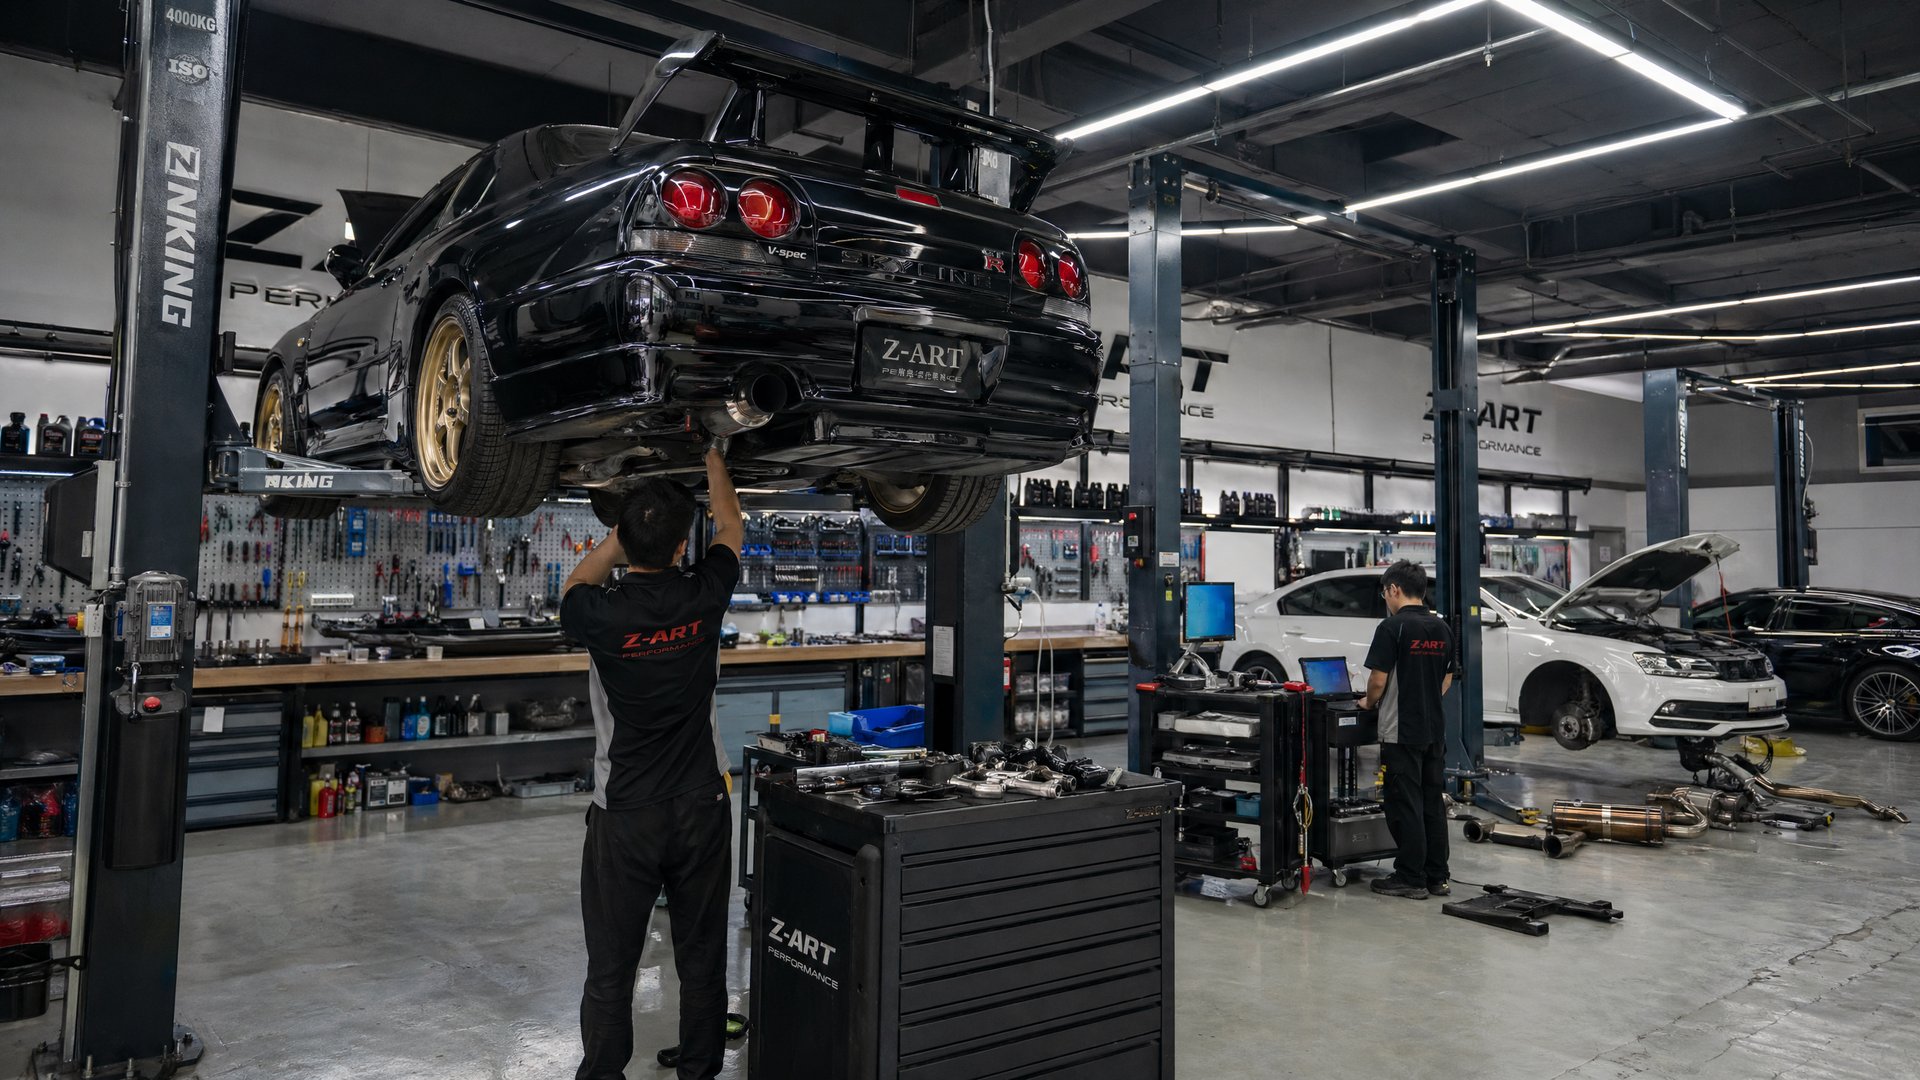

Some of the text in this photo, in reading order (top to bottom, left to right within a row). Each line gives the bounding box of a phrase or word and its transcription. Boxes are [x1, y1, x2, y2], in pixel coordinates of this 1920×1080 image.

[166, 7, 216, 33] 4000KG
[168, 57, 209, 80] ISO
[768, 245, 808, 261] V-spec
[229, 281, 335, 309] PER
[882, 337, 964, 370] Z-ART
[1422, 433, 1542, 457] PORMANCE
[621, 618, 703, 649] Z-ART
[768, 915, 837, 966] Z-ART
[766, 944, 839, 990] PERFORMANCE
